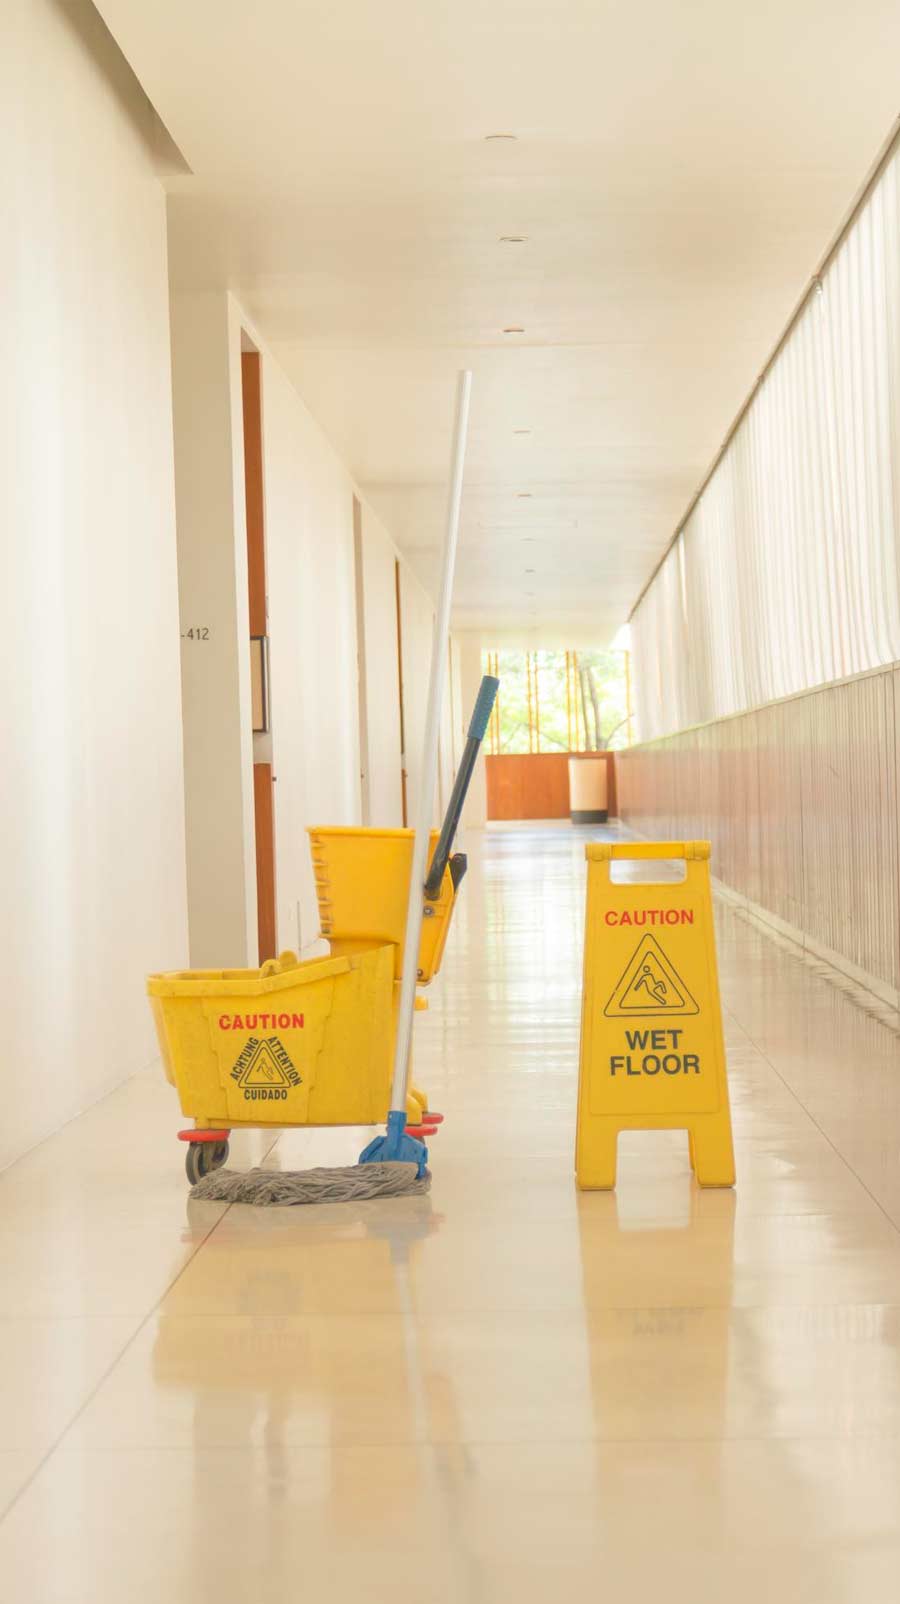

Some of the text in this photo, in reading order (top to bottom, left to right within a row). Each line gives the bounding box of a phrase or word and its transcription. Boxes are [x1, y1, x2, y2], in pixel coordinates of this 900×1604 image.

[604, 909, 694, 927] CAUTION
[218, 1013, 305, 1030] CAUTION
[625, 1029, 683, 1051] WET
[230, 1037, 260, 1081] ACHTUNG
[267, 1036, 303, 1087] ATTENTION
[609, 1054, 701, 1077] FLOOR
[243, 1089, 288, 1101] CUIDADO
